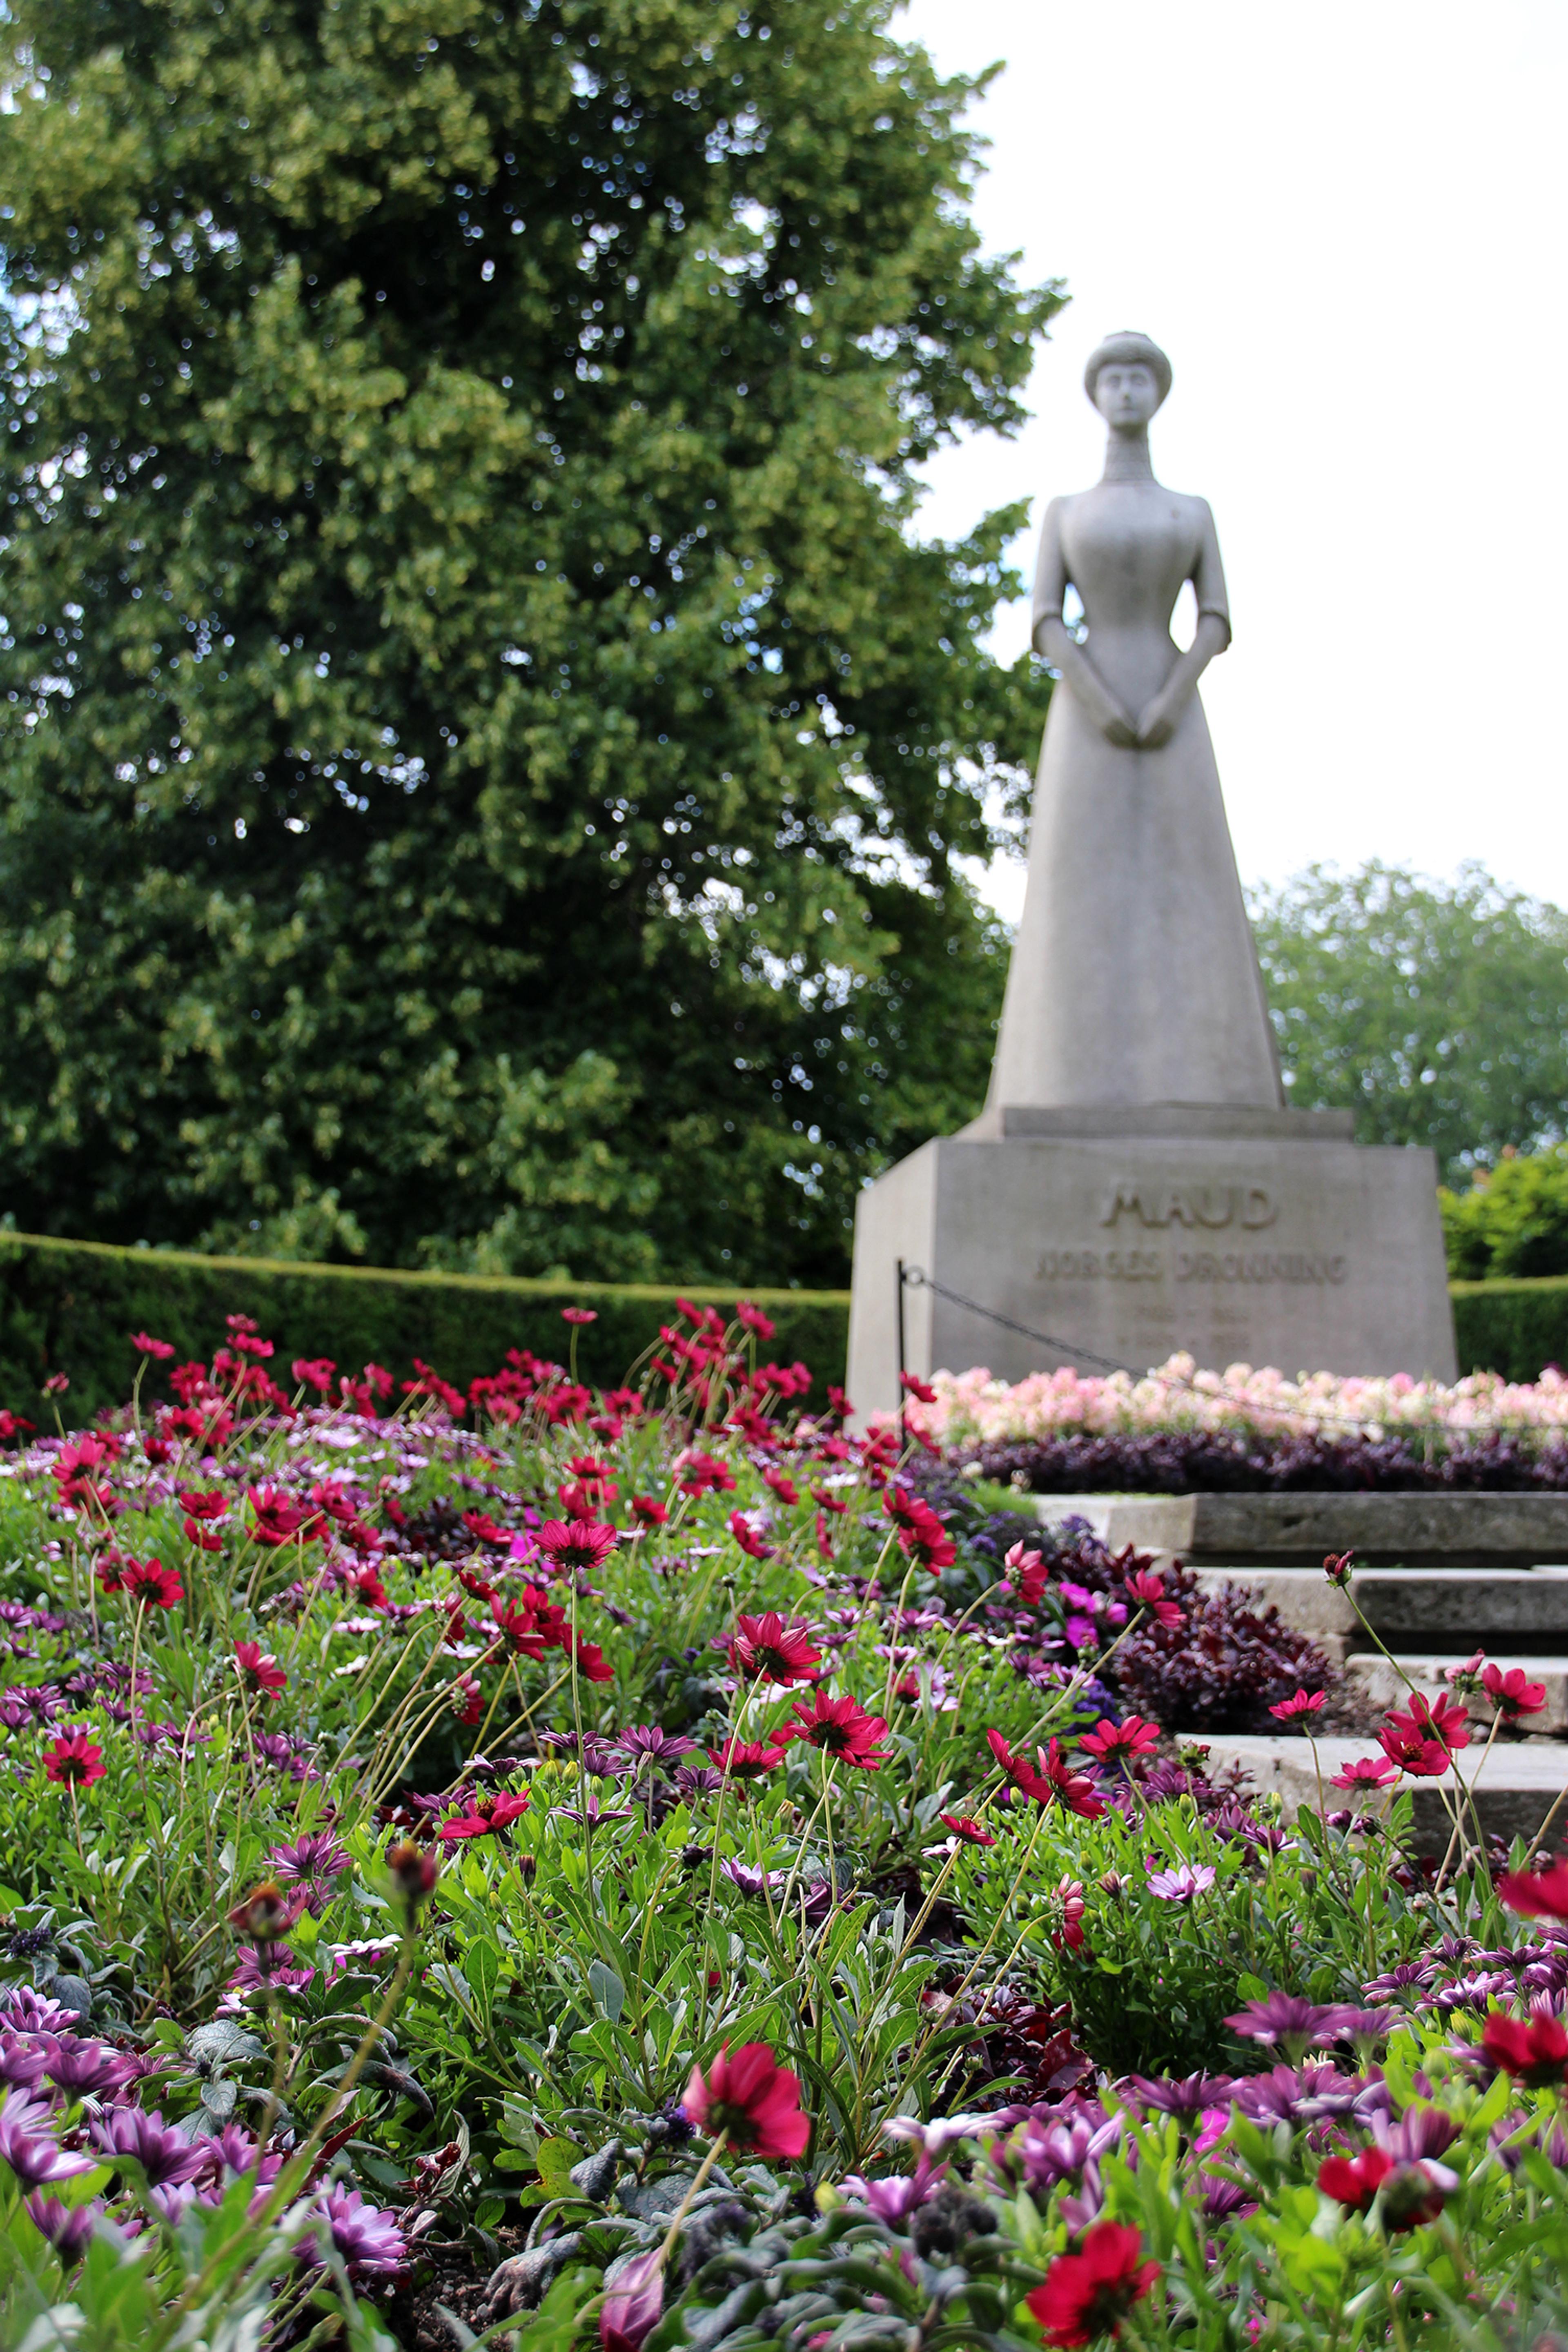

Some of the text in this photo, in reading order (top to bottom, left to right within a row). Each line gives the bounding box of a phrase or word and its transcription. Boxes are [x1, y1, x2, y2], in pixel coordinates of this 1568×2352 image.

[1099, 1187, 1279, 1229] MAUD
[1037, 1250, 1348, 1285] NORGES DRONNING
